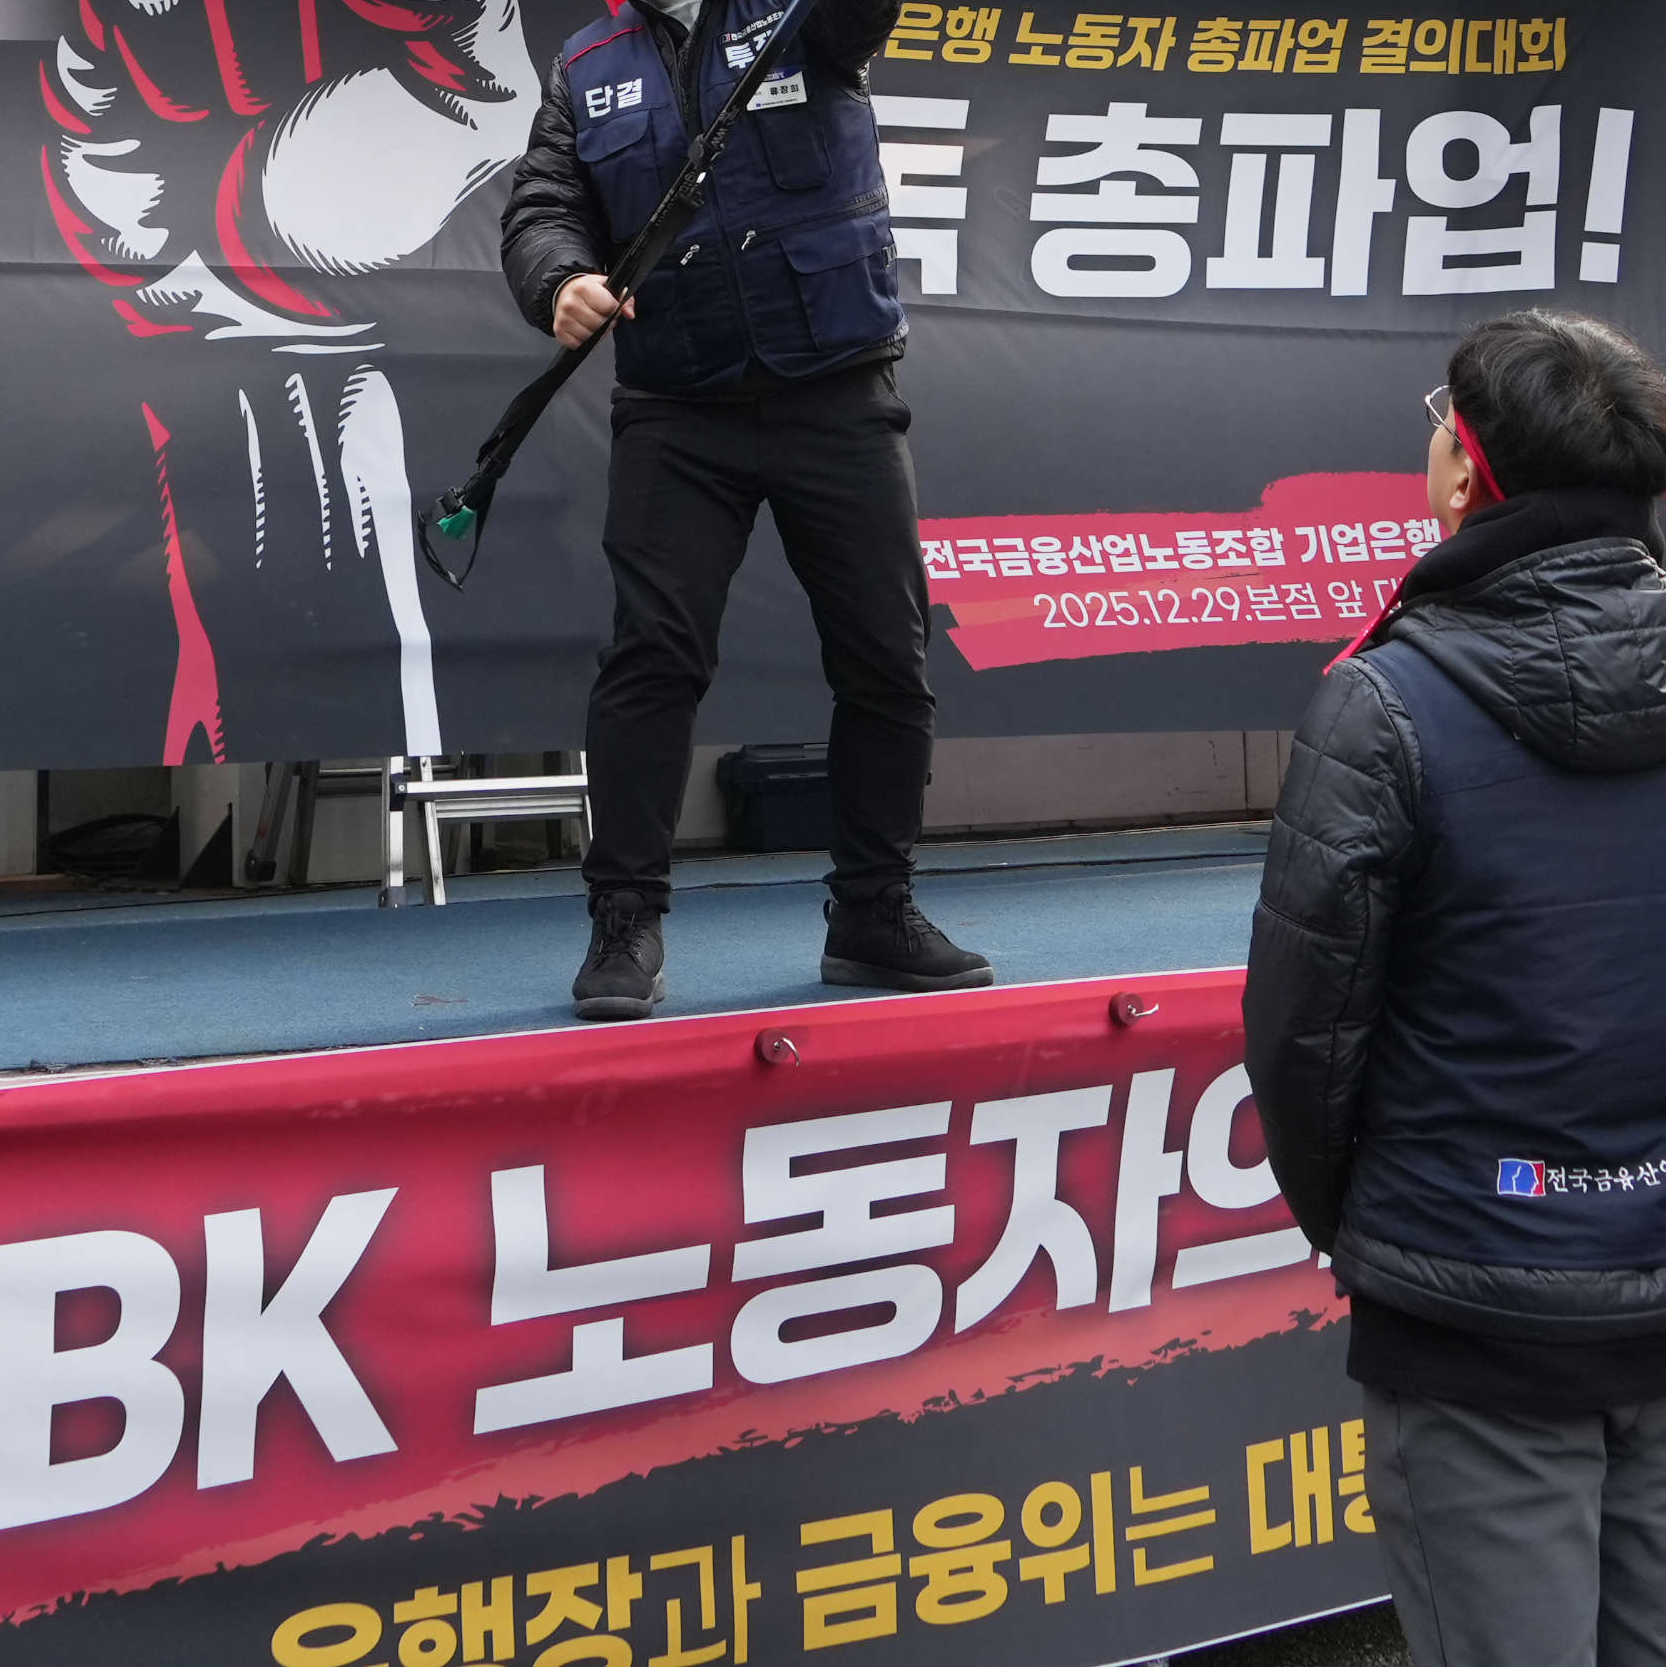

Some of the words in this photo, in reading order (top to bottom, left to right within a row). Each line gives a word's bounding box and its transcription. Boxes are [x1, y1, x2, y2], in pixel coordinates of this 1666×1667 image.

[884, 1, 1002, 64] 은행
[1008, 12, 1177, 72] 노동자
[1186, 16, 1341, 76] 총파업
[1362, 18, 1567, 76] 결의대회
[585, 77, 643, 118] 단결
[870, 94, 970, 295] 독
[1029, 102, 1637, 298] 총파업!
[923, 527, 1285, 580] 전국금융산업노동조합
[1328, 581, 1367, 618] 앞
[795, 1466, 1217, 1652] 금융위는
